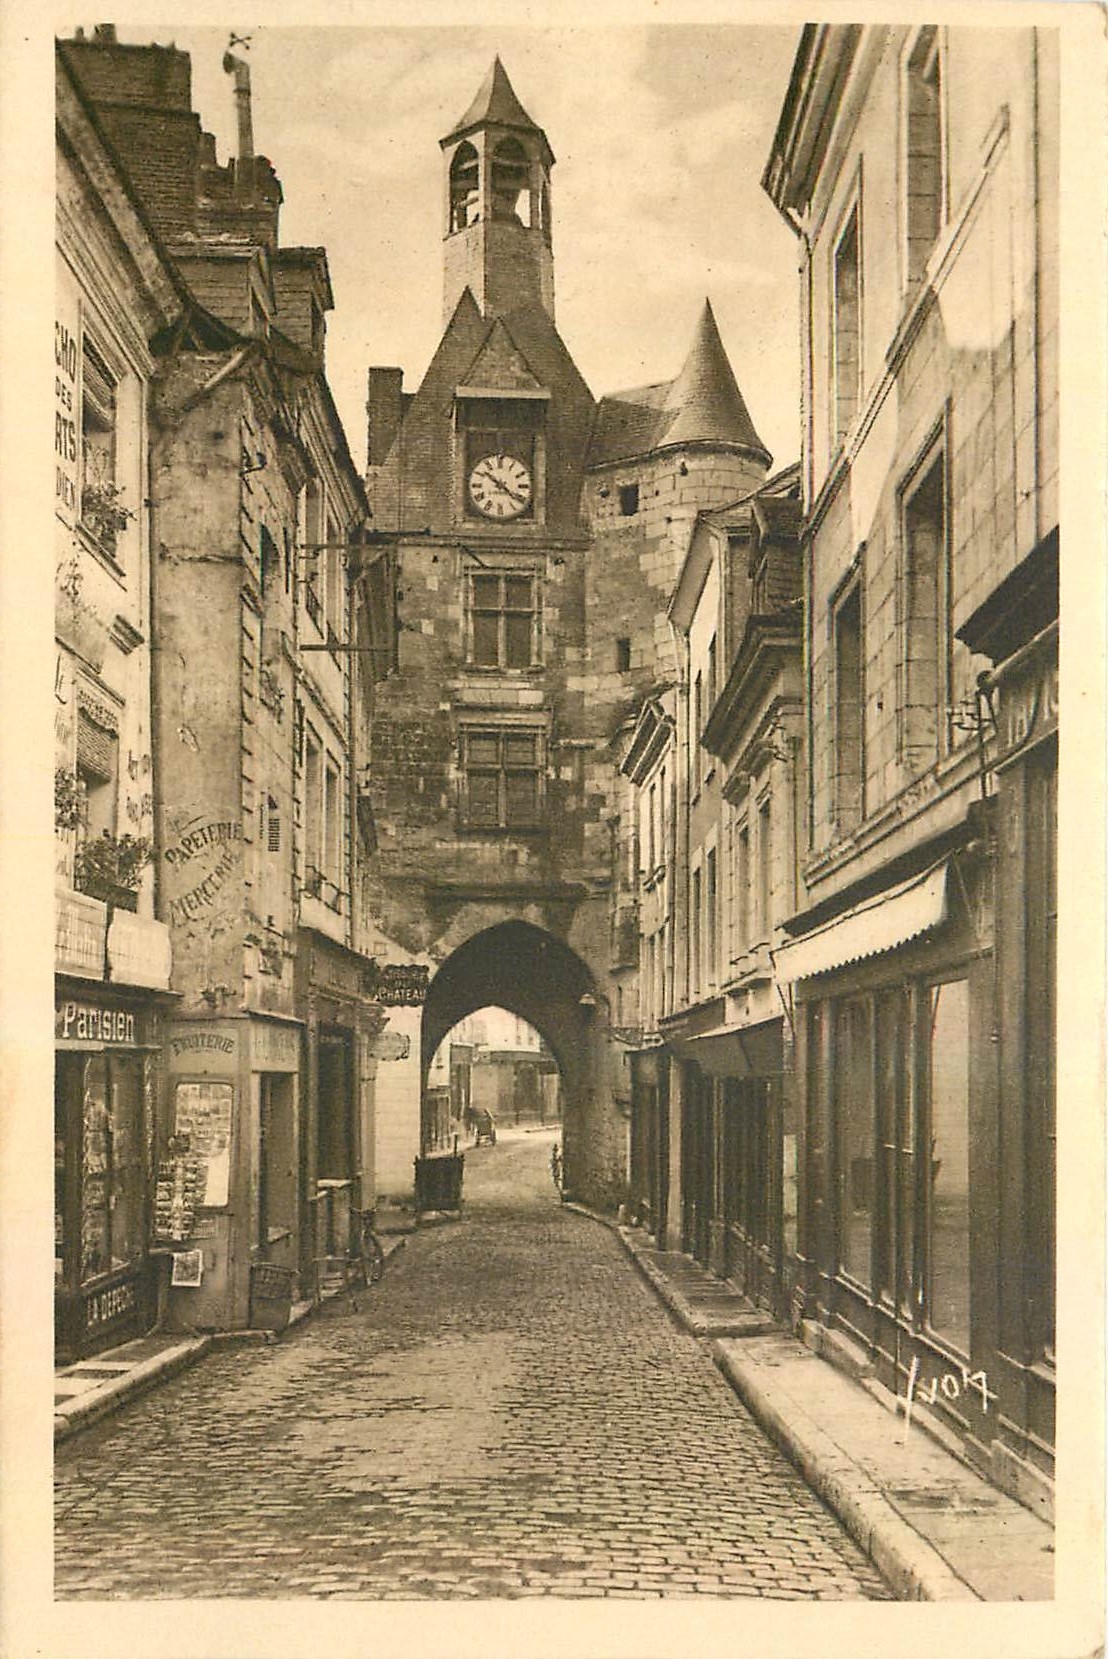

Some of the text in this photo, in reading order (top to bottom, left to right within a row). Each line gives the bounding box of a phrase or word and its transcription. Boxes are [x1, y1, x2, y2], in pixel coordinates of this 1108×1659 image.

[165, 822, 243, 864] PAPETERIE
[168, 853, 239, 928] MERCERIE
[62, 1002, 134, 1042] Parisien
